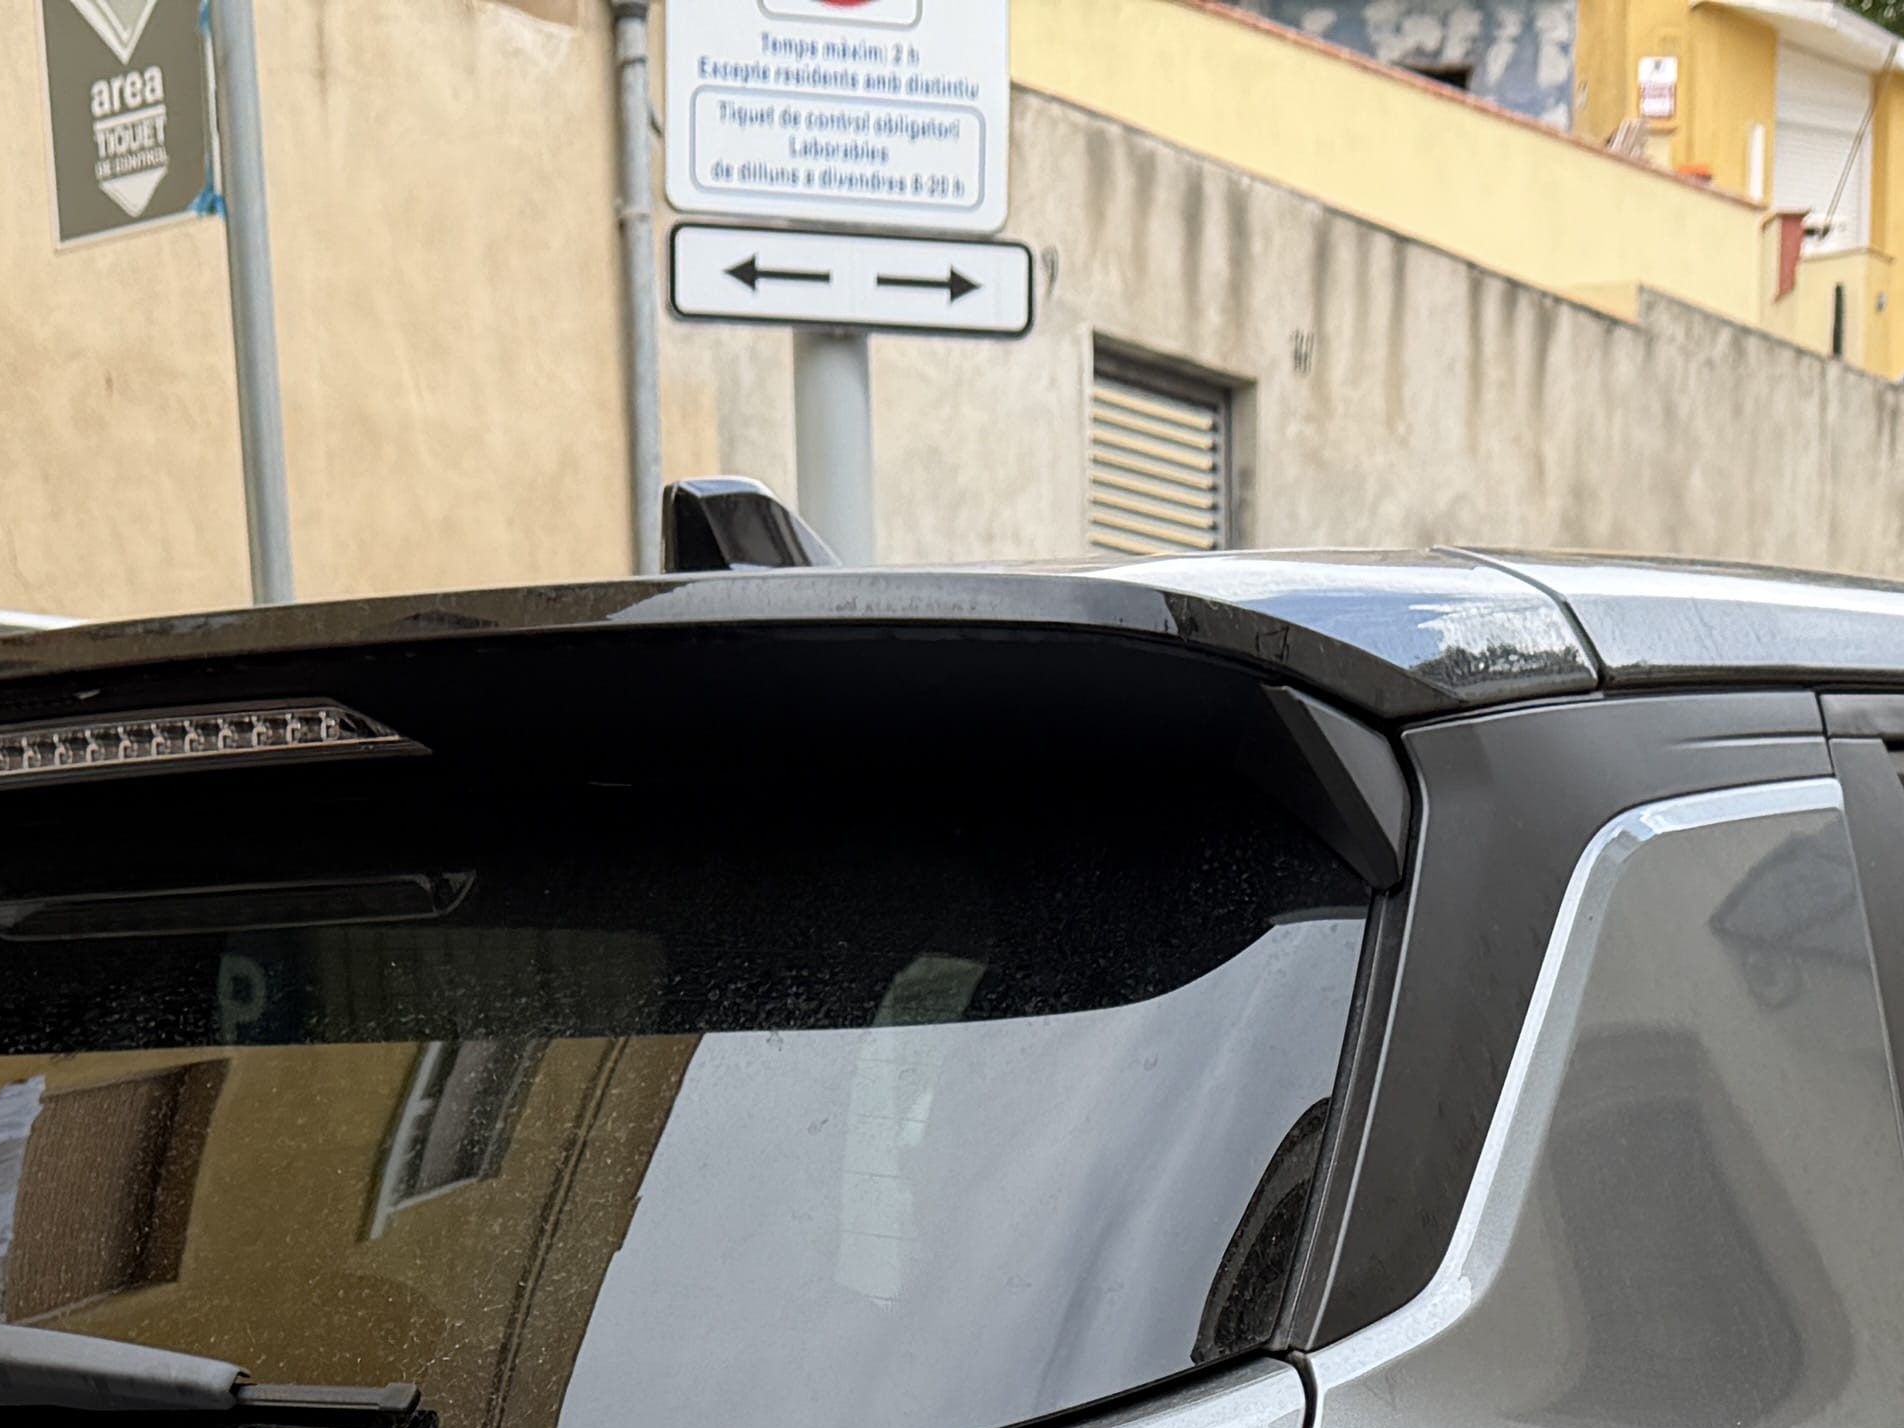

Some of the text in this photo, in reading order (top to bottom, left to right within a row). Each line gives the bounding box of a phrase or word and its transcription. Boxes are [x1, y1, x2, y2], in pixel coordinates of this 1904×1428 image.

[760, 31, 818, 59] Temps
[892, 43, 903, 65] 2
[907, 44, 920, 66] h
[91, 65, 163, 117] area
[698, 55, 979, 99] Excepte residents amb distintiu
[94, 114, 167, 159] TIQUET
[719, 100, 960, 142] Tiquet de control obligatori
[789, 134, 889, 163] Laborables
[711, 158, 734, 181] de
[738, 161, 798, 184] dilluns
[804, 169, 815, 187] a
[819, 165, 906, 191] divendres
[952, 176, 965, 197] h
